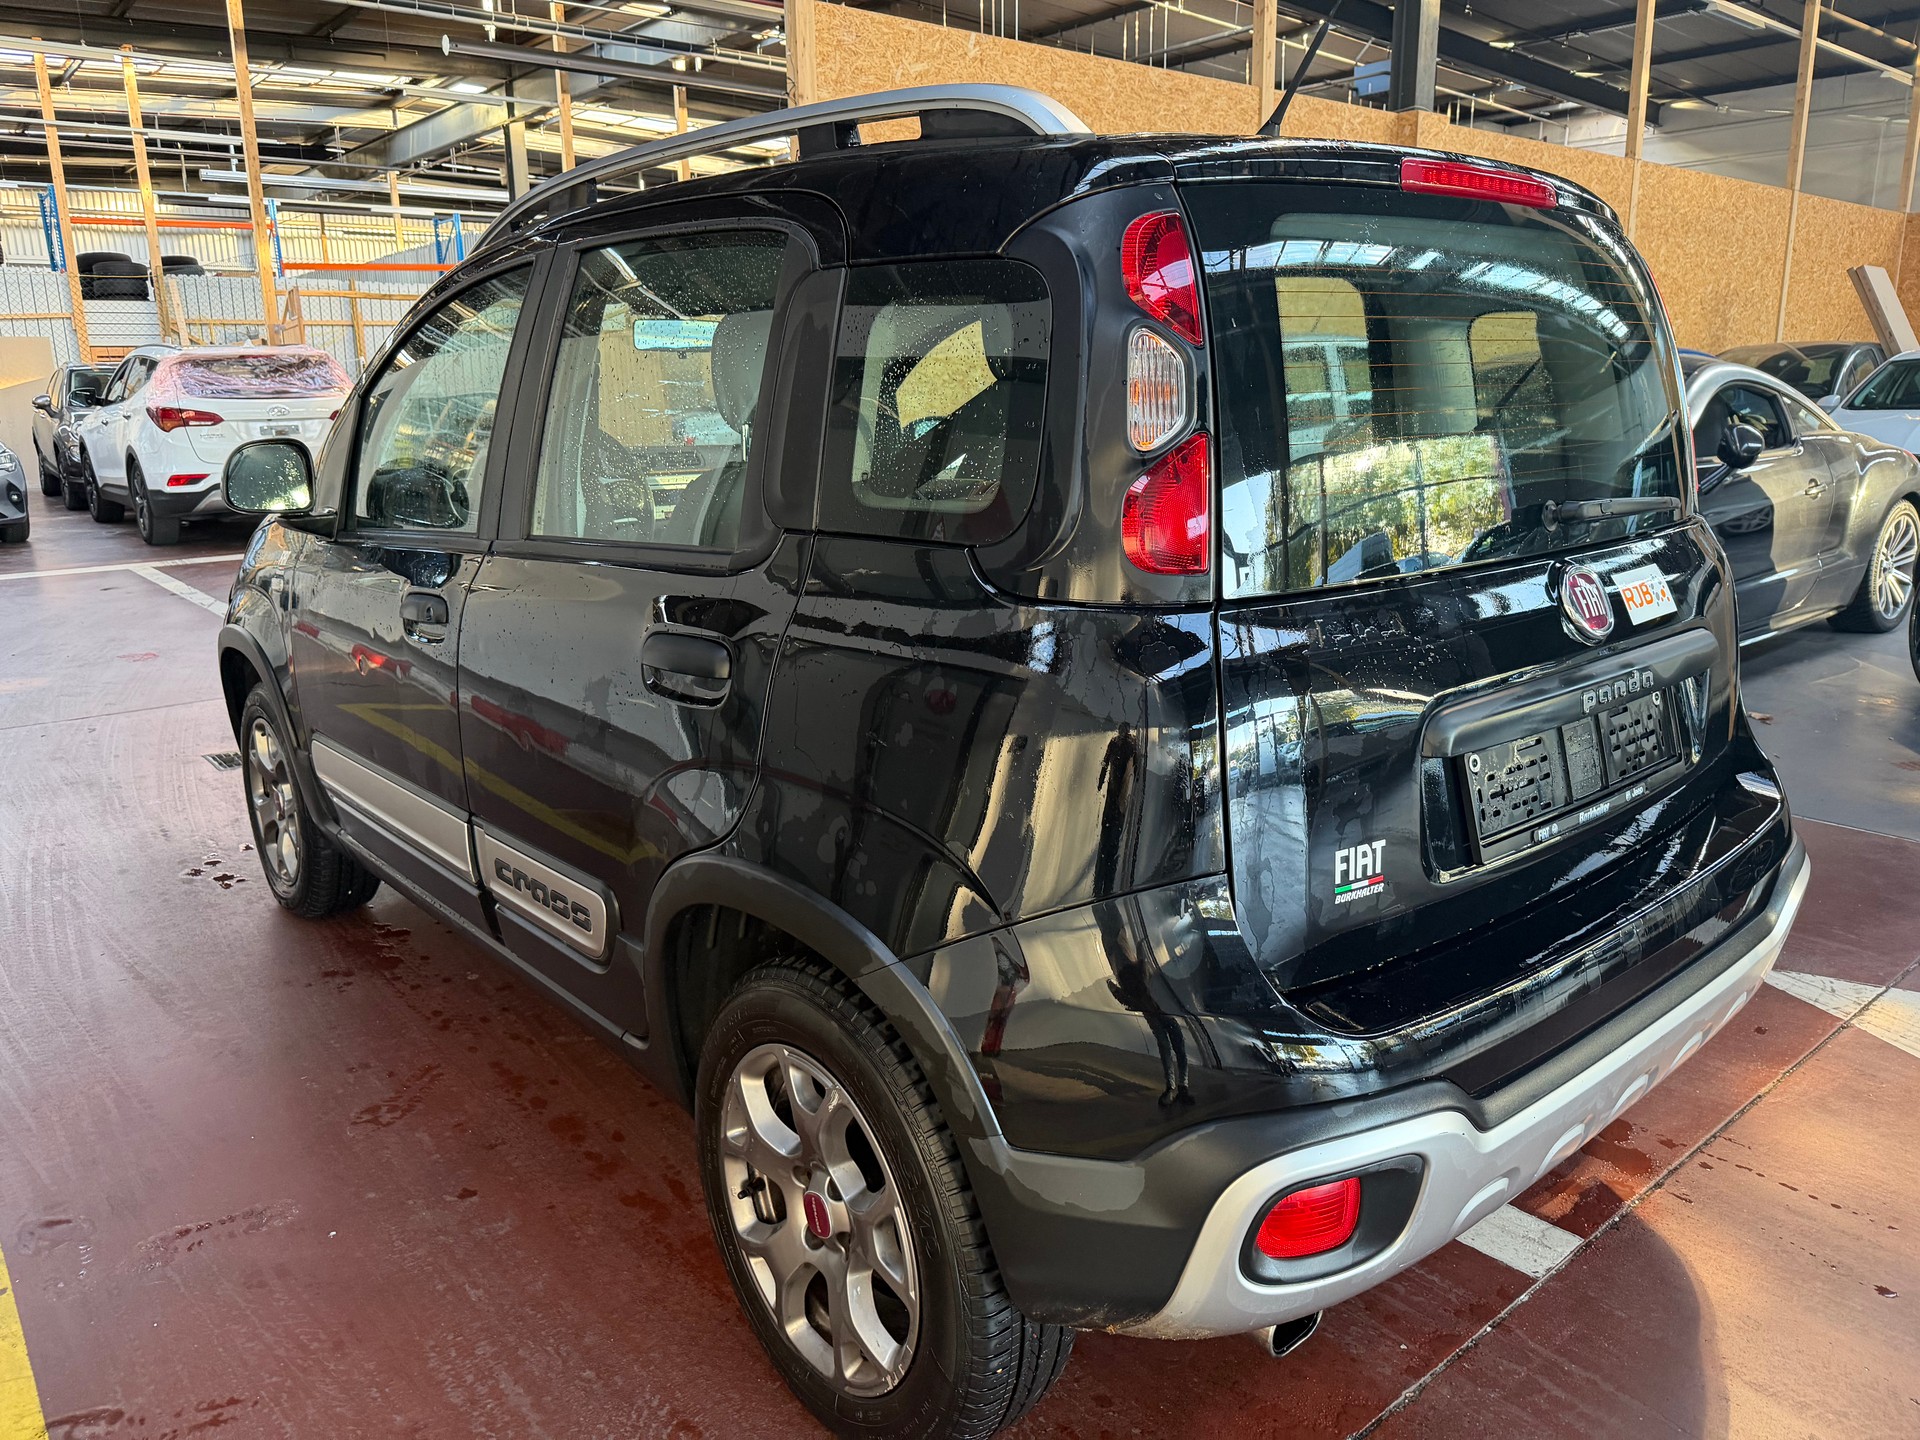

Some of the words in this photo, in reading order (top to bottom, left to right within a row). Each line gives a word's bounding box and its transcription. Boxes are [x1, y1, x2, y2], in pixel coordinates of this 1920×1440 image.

[1574, 583, 1606, 619] FIAT
[1622, 582, 1654, 611] RJB
[1335, 839, 1386, 885] FIAT
[1335, 883, 1385, 904] BURKHALTER
